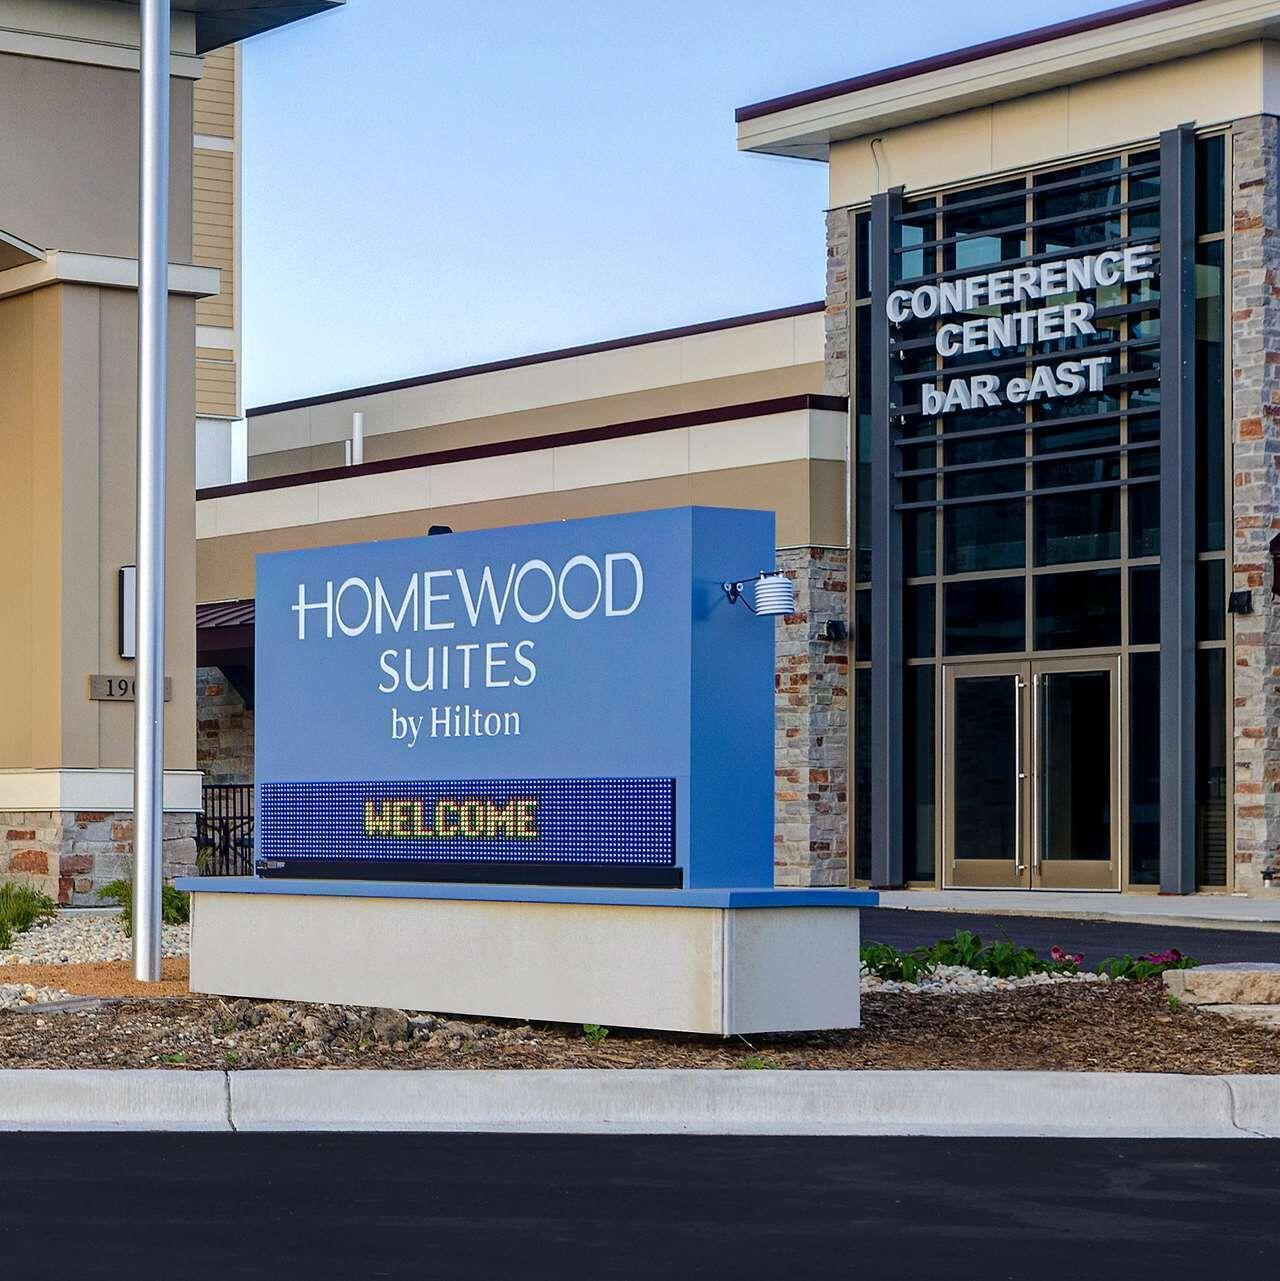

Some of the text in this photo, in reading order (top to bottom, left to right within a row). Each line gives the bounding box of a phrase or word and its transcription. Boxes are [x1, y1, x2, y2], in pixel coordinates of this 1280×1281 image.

[886, 245, 1154, 323] CONFERENCE
[936, 302, 1097, 357] CENTER
[921, 356, 1112, 416] bAR eAST
[291, 552, 644, 640] HOMEWOOD
[378, 640, 537, 693] SUITES
[391, 706, 522, 748] by Hilton
[363, 799, 539, 838] WELCOME
